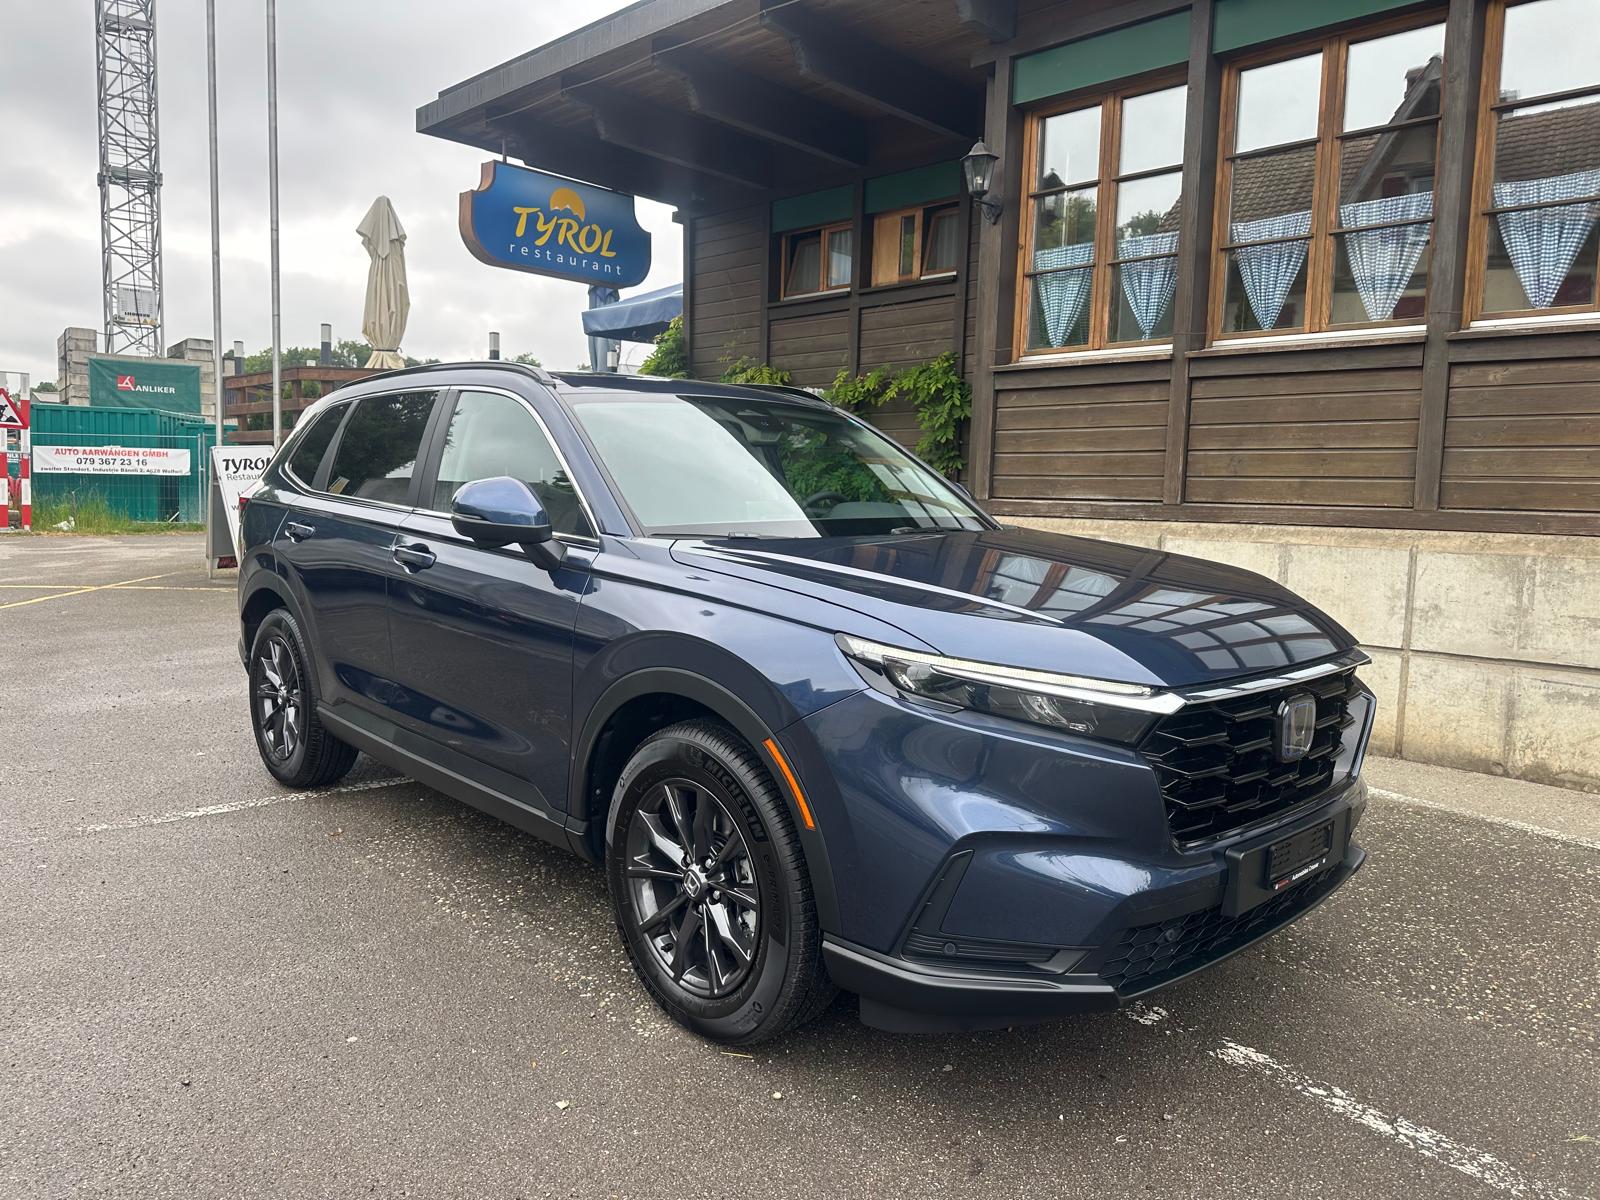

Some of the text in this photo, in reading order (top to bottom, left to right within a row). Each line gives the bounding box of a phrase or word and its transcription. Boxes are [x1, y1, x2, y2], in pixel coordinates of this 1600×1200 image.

[513, 206, 617, 257] TYROL
[509, 243, 622, 275] restaurant
[135, 385, 176, 394] ANLIKER
[54, 448, 79, 456] AUTO
[142, 450, 168, 458] GMBH
[76, 457, 95, 465] 079
[120, 458, 132, 466] 23
[704, 759, 769, 842] MICHELIN
